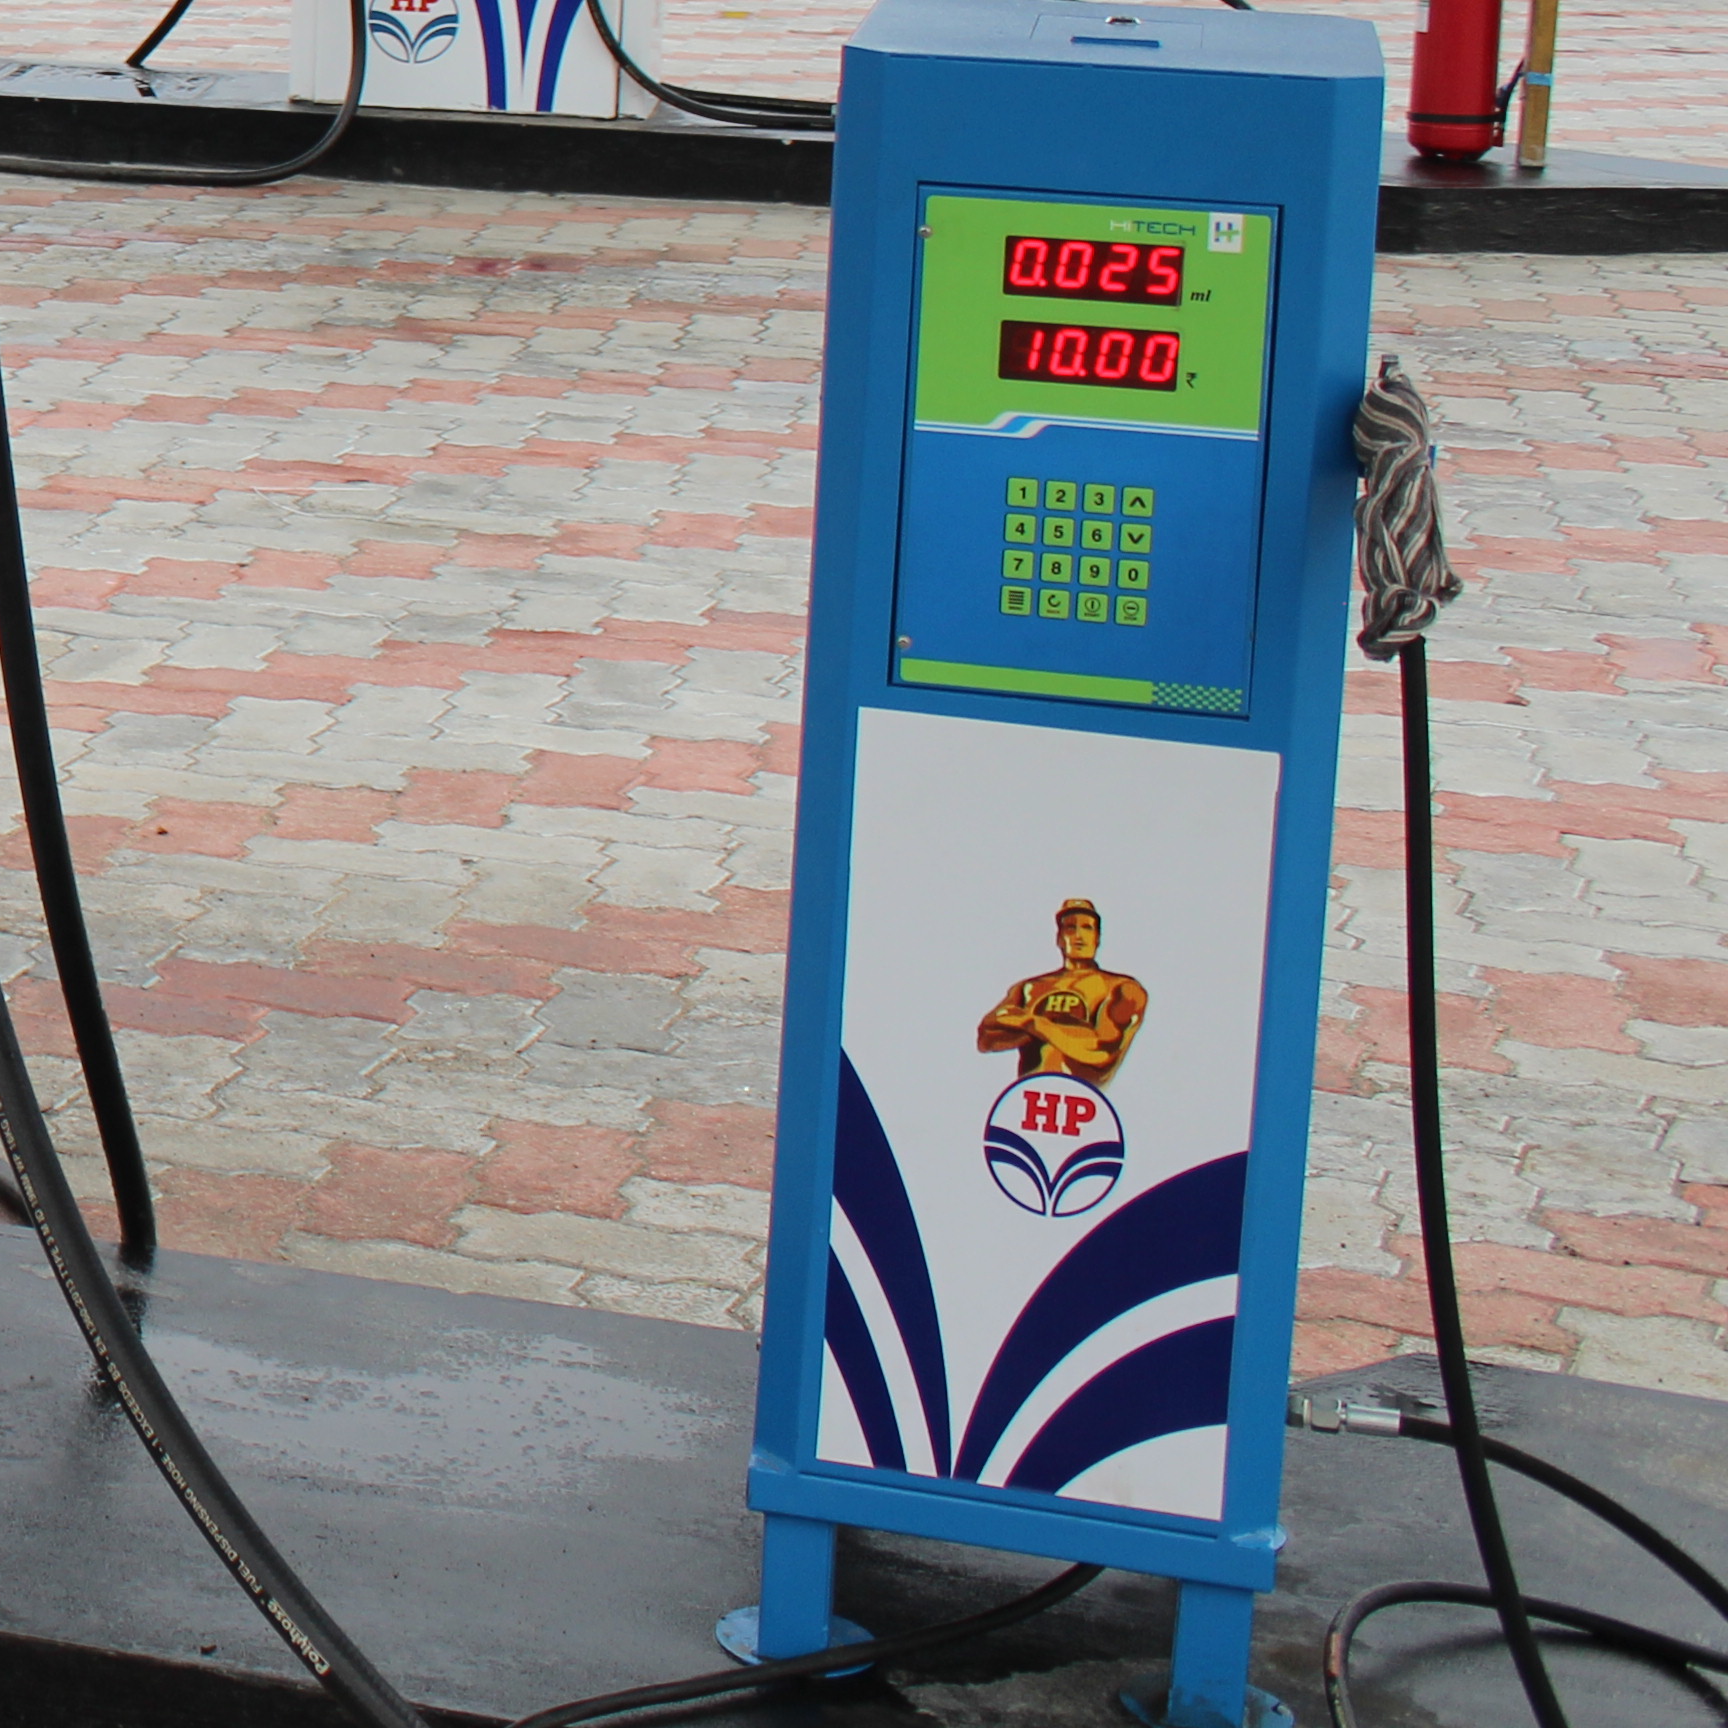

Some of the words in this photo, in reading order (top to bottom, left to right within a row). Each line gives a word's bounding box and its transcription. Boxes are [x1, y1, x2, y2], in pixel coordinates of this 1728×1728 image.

[1008, 238, 1182, 295] 0.025
[1190, 288, 1211, 302] ml
[1027, 328, 1180, 383] 10.00
[1018, 486, 1028, 500] 1
[1055, 489, 1066, 503] 2
[1093, 492, 1105, 506] 3
[1014, 522, 1026, 536] 4
[1053, 525, 1064, 539] 5
[1091, 528, 1102, 543] 6
[1013, 558, 1023, 572] 7
[1051, 561, 1062, 575] 8
[1089, 564, 1100, 579] 9
[1128, 568, 1139, 582] 0
[1046, 995, 1080, 1013] HP
[1021, 1090, 1097, 1137] HP
[11, 1151, 26, 1172] WP
[48, 1244, 71, 1278] TYPE
[92, 1335, 109, 1355] EN
[105, 1360, 122, 1381] BS
[115, 1378, 155, 1438] EXCEEDS
[157, 1452, 189, 1490] HOSE
[180, 1486, 240, 1562] DISPENSING
[233, 1558, 264, 1594] FUEL
[262, 1594, 332, 1677] Polyhose
